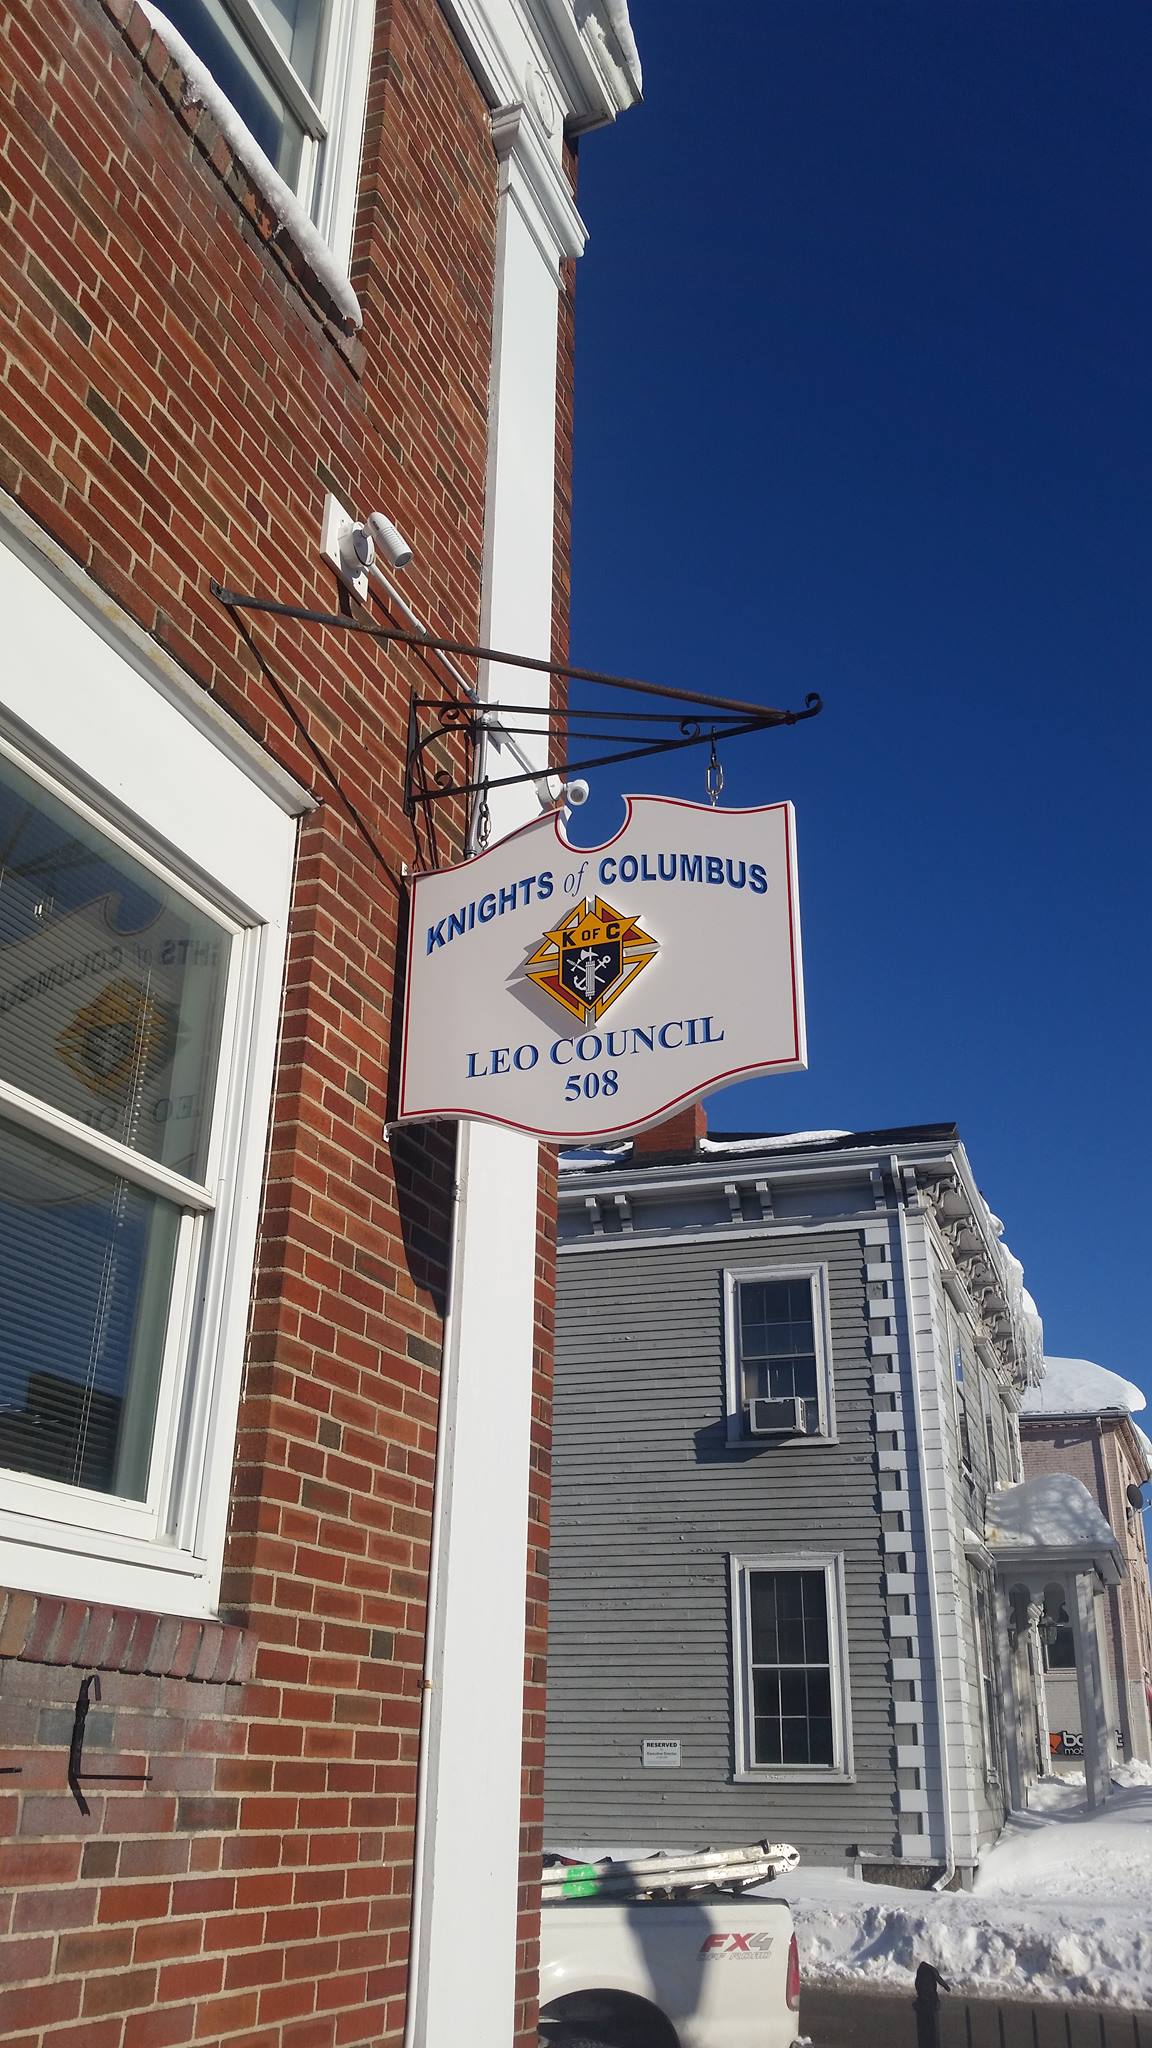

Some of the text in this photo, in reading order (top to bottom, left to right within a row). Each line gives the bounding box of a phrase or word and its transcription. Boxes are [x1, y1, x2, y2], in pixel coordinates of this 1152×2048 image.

[426, 853, 769, 956] KNIGHTS of COLUMBUS
[562, 923, 620, 947] K OF C
[465, 1015, 725, 1078] LEO COUNCIL
[564, 1069, 619, 1102] 508
[699, 1932, 774, 1952] FX4
